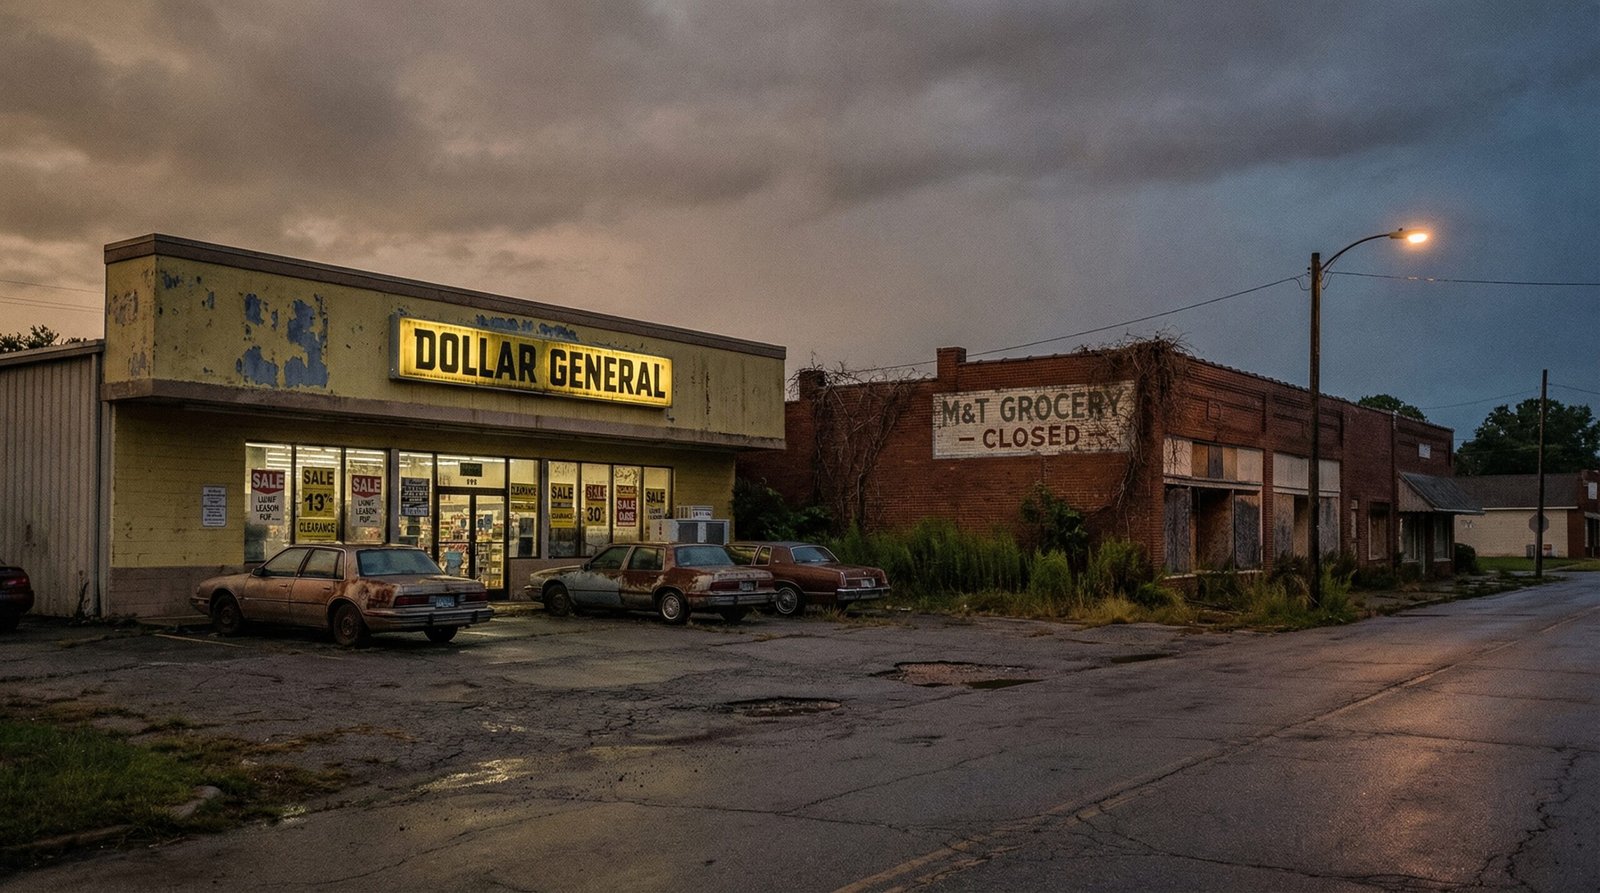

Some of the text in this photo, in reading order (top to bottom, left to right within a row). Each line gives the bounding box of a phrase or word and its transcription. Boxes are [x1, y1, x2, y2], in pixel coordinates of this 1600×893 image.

[414, 328, 666, 399] DOLLAR GENERAL
[942, 390, 1124, 427] M&T GROCERY
[252, 472, 284, 489] SALE
[303, 470, 334, 486] SALE
[353, 477, 381, 492] SALE
[552, 486, 574, 500] SALE
[646, 491, 665, 504] SALE
[618, 500, 636, 510] SALE
